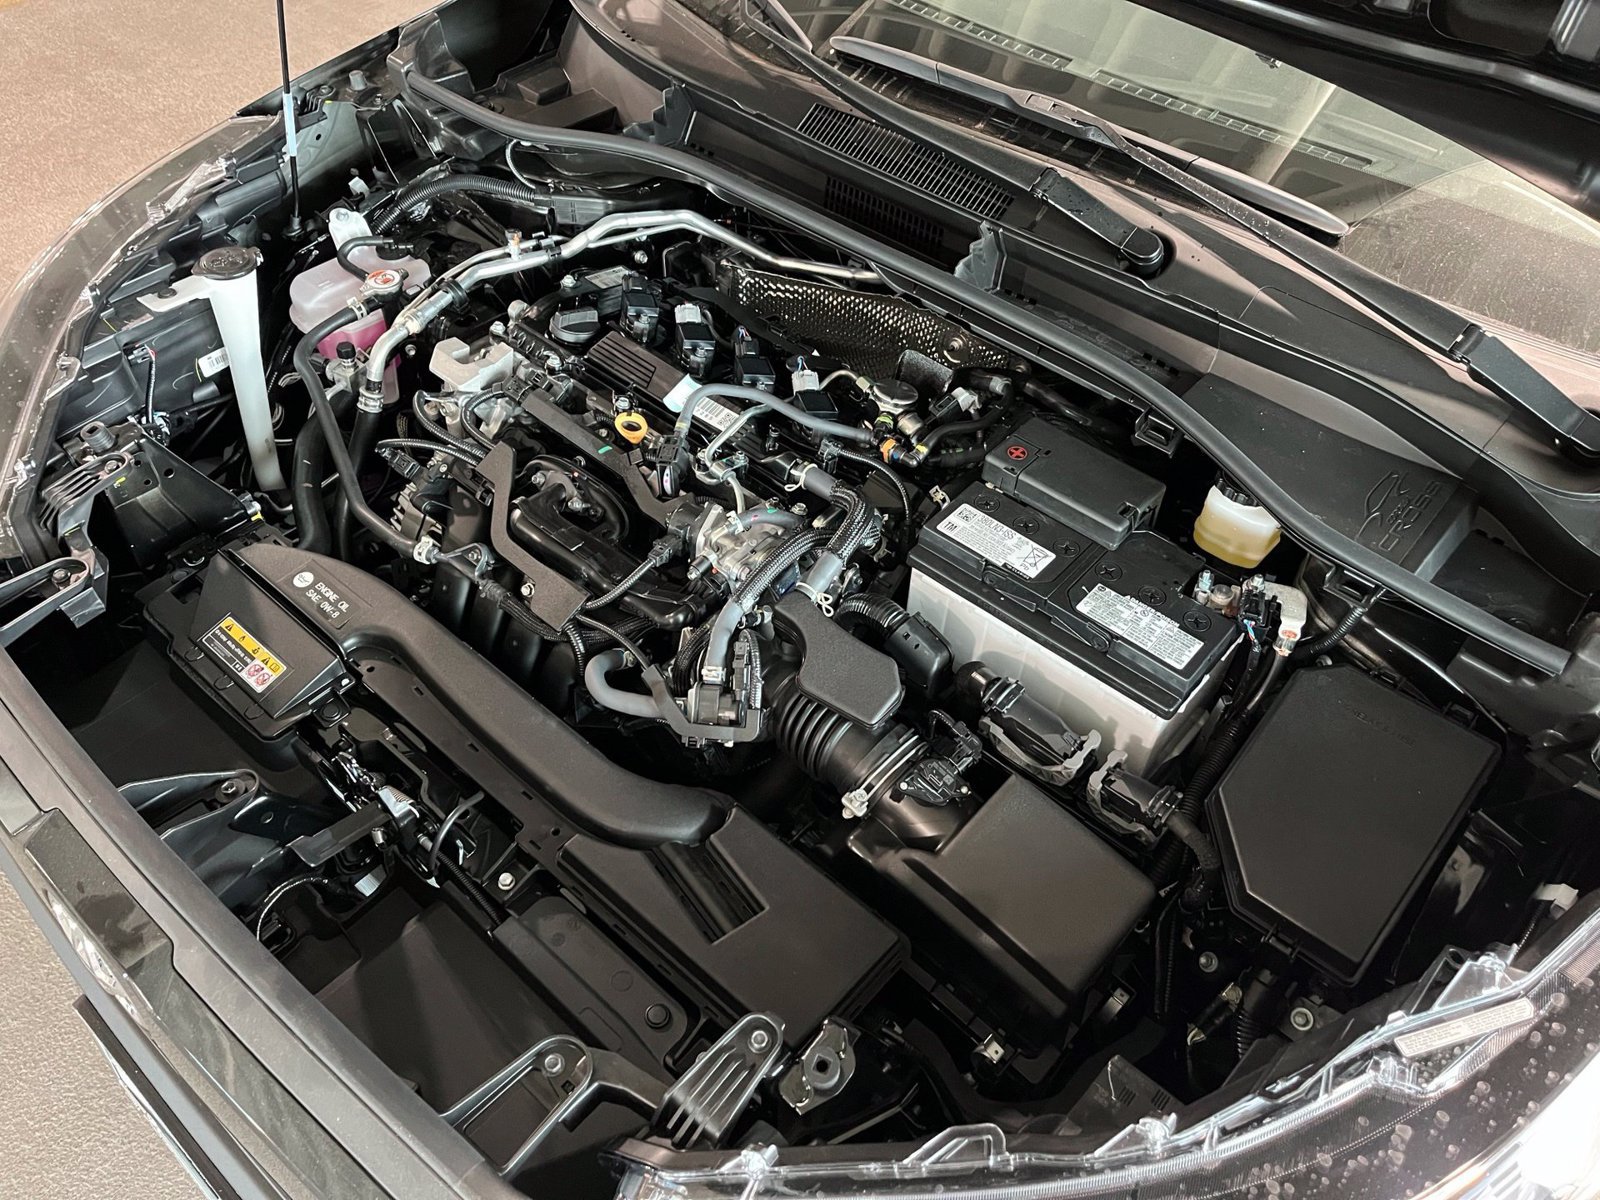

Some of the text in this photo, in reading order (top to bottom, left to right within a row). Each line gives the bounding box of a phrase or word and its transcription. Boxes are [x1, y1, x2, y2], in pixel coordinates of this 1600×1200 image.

[943, 521, 958, 532] TM
[980, 515, 1016, 540] 380LN3-ISS
[1379, 481, 1441, 552] CROSS
[305, 589, 340, 619] SAE 0W-8
[315, 582, 350, 613] ENGINE OIL
